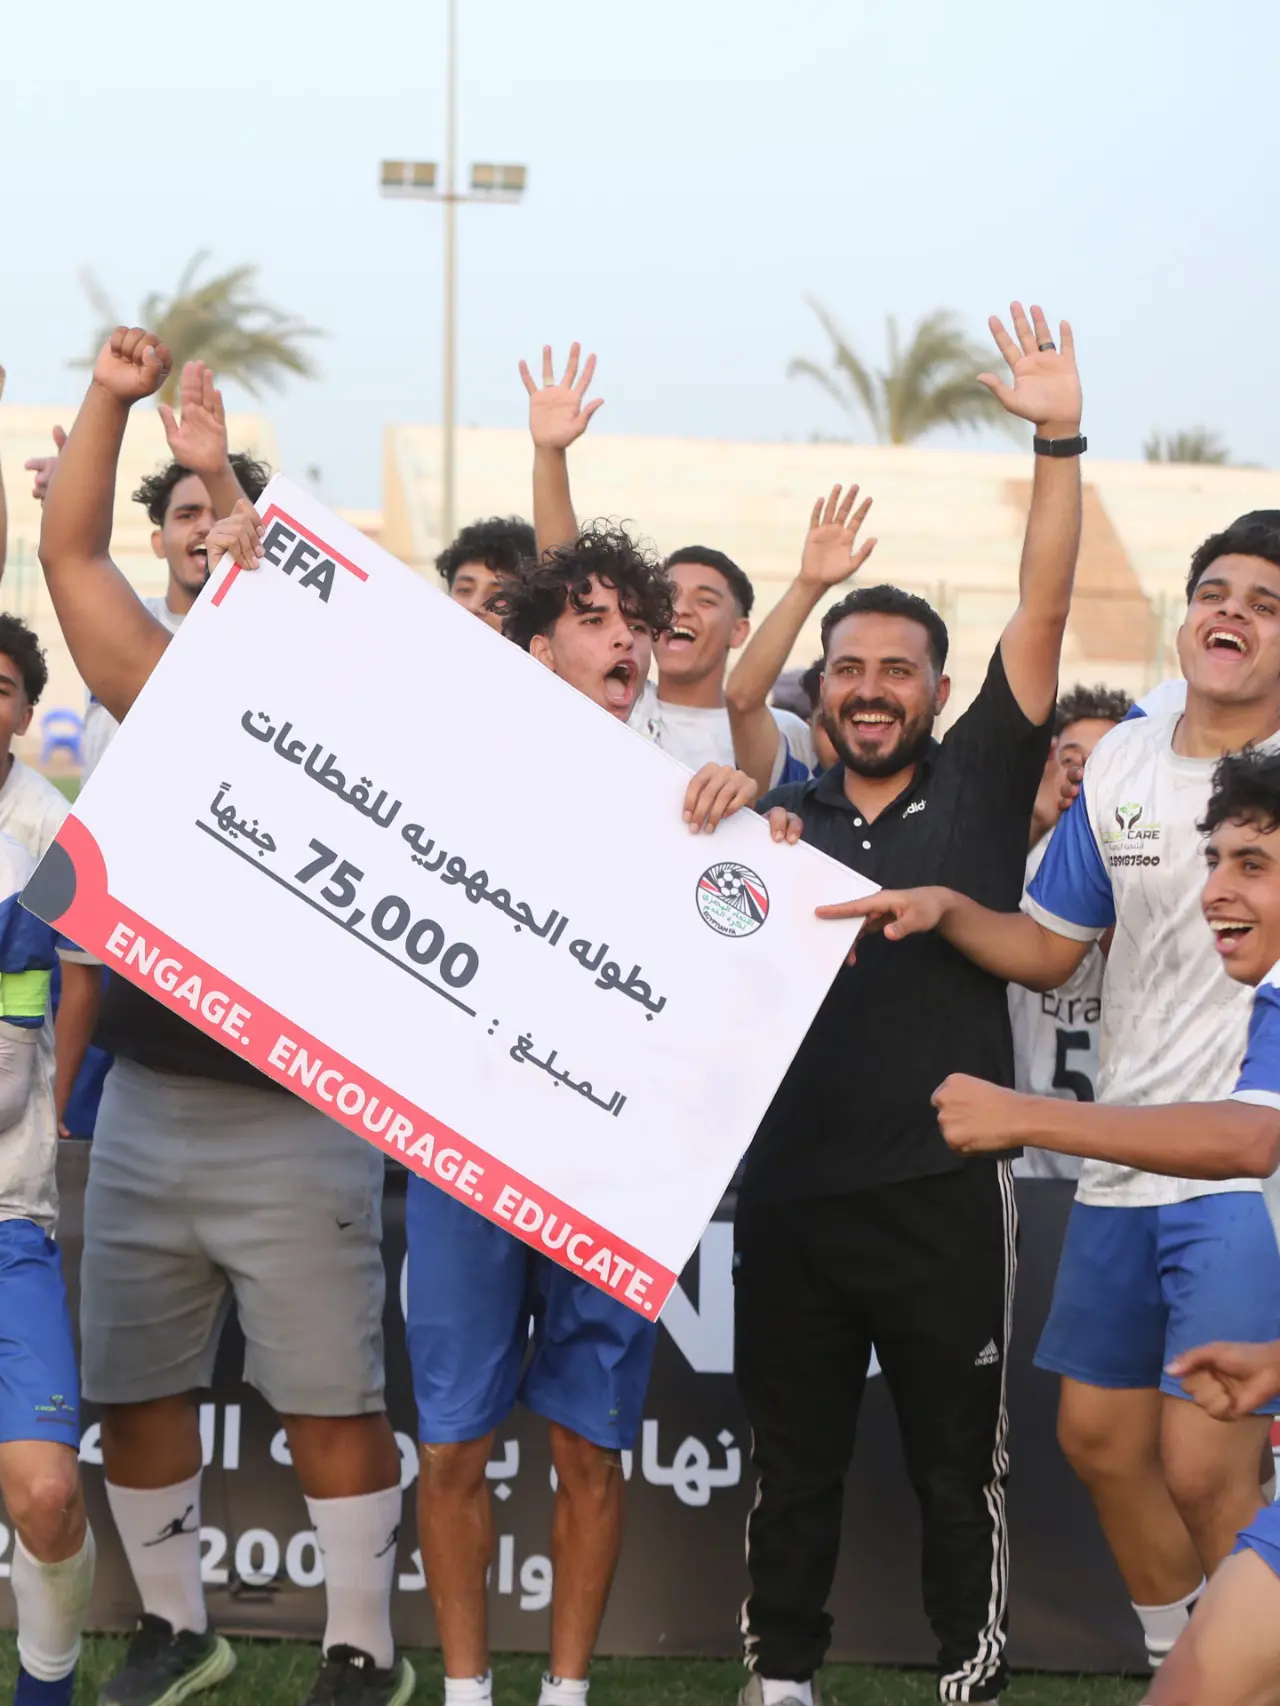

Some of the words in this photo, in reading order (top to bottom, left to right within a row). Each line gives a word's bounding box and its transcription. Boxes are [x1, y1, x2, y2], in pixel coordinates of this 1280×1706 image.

[262, 521, 336, 603] EFA
[241, 709, 403, 829] للقطاعات
[1127, 830, 1160, 840] CARE
[295, 838, 480, 989] 75,000
[401, 823, 569, 947] الجمهوريه
[703, 910, 728, 933] EGYPTIAN
[569, 938, 667, 1021] بطوله
[509, 1032, 627, 1117] المبلغ
[1051, 1028, 1095, 1102] 5
[105, 921, 252, 1046] ENGAGE.
[267, 1034, 484, 1202] ENCOURAGE.
[492, 1184, 655, 1311] EDUCATE.
